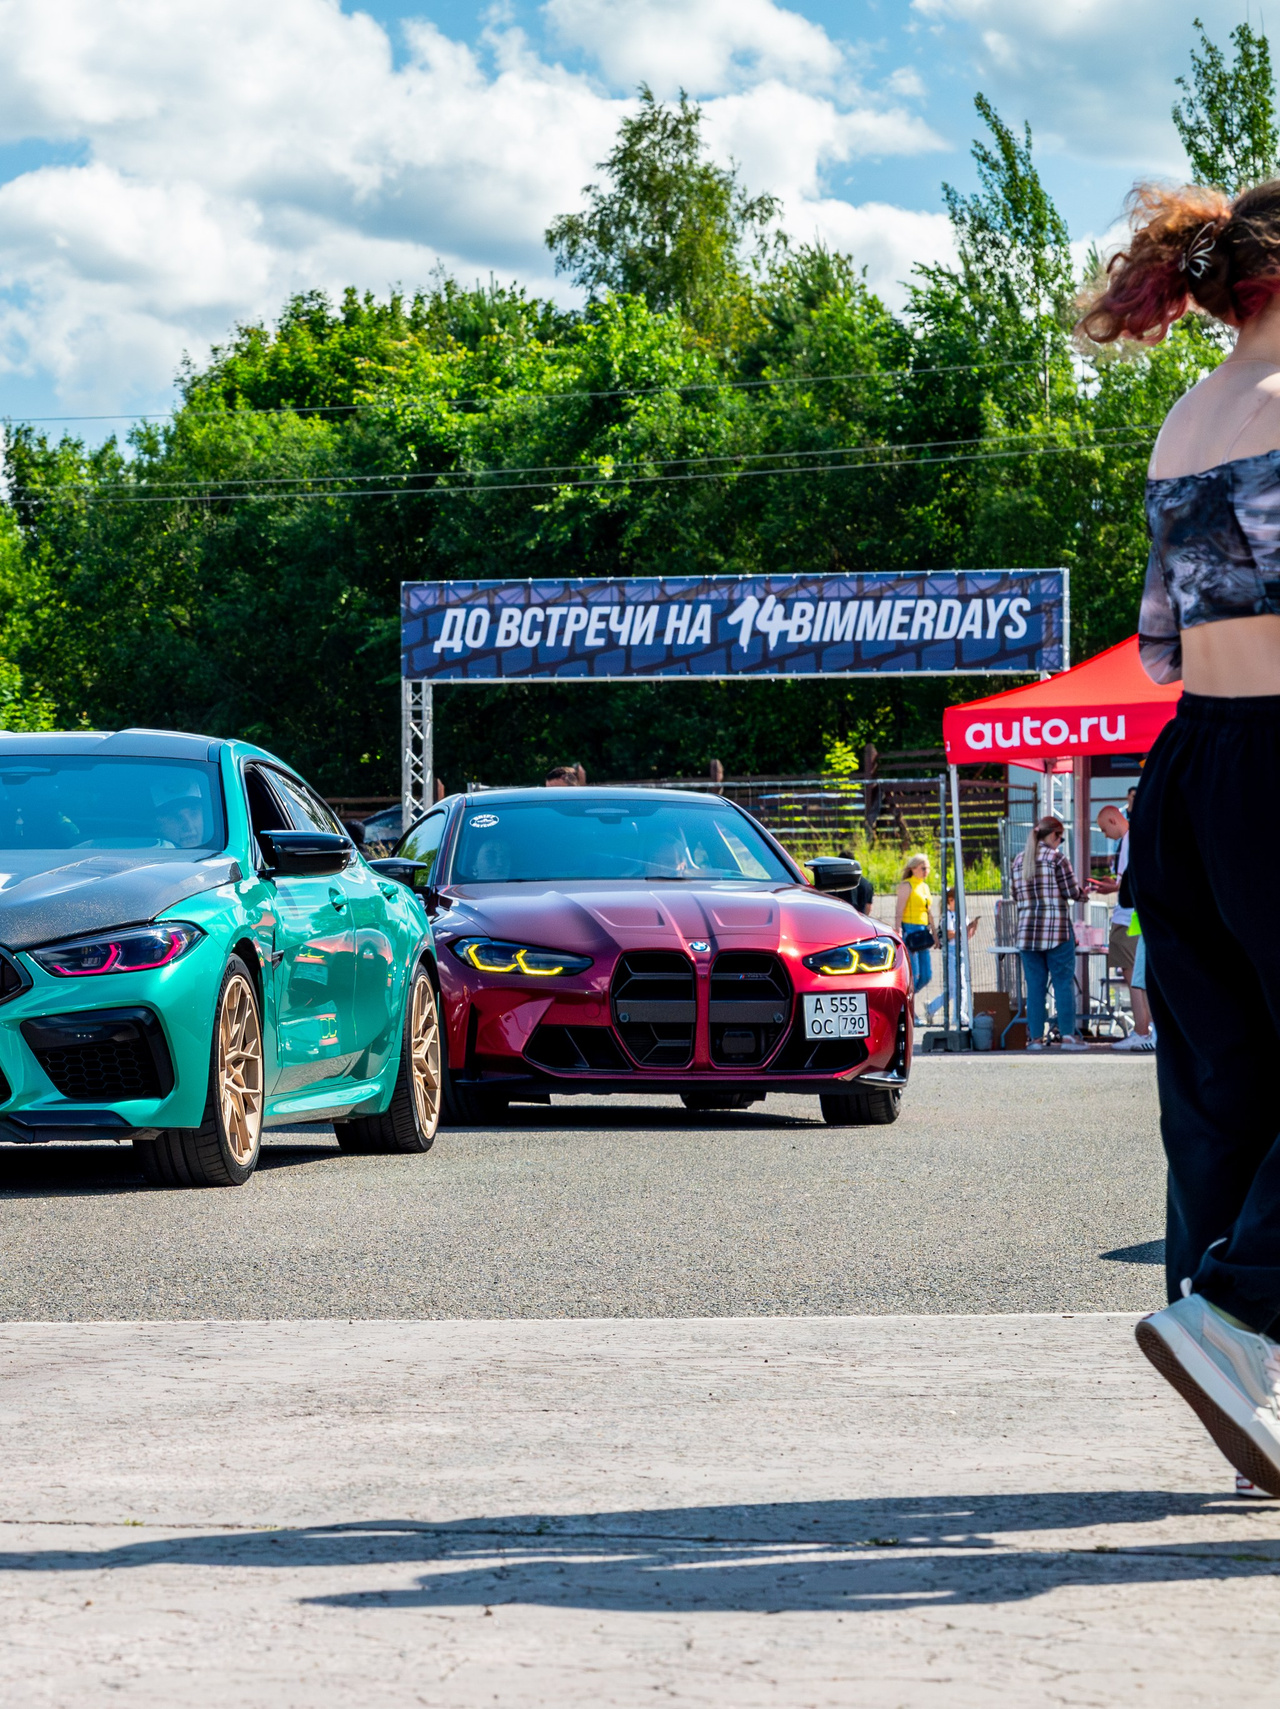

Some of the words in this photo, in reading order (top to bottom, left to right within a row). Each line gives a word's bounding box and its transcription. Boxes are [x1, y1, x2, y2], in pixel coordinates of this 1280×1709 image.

[433, 607, 490, 653] ДО
[495, 604, 659, 648] ВСТРЕЧИ
[663, 604, 712, 645] НА
[965, 715, 1126, 750] auto.ru
[830, 996, 858, 1013] 555
[842, 1016, 865, 1030] 790
